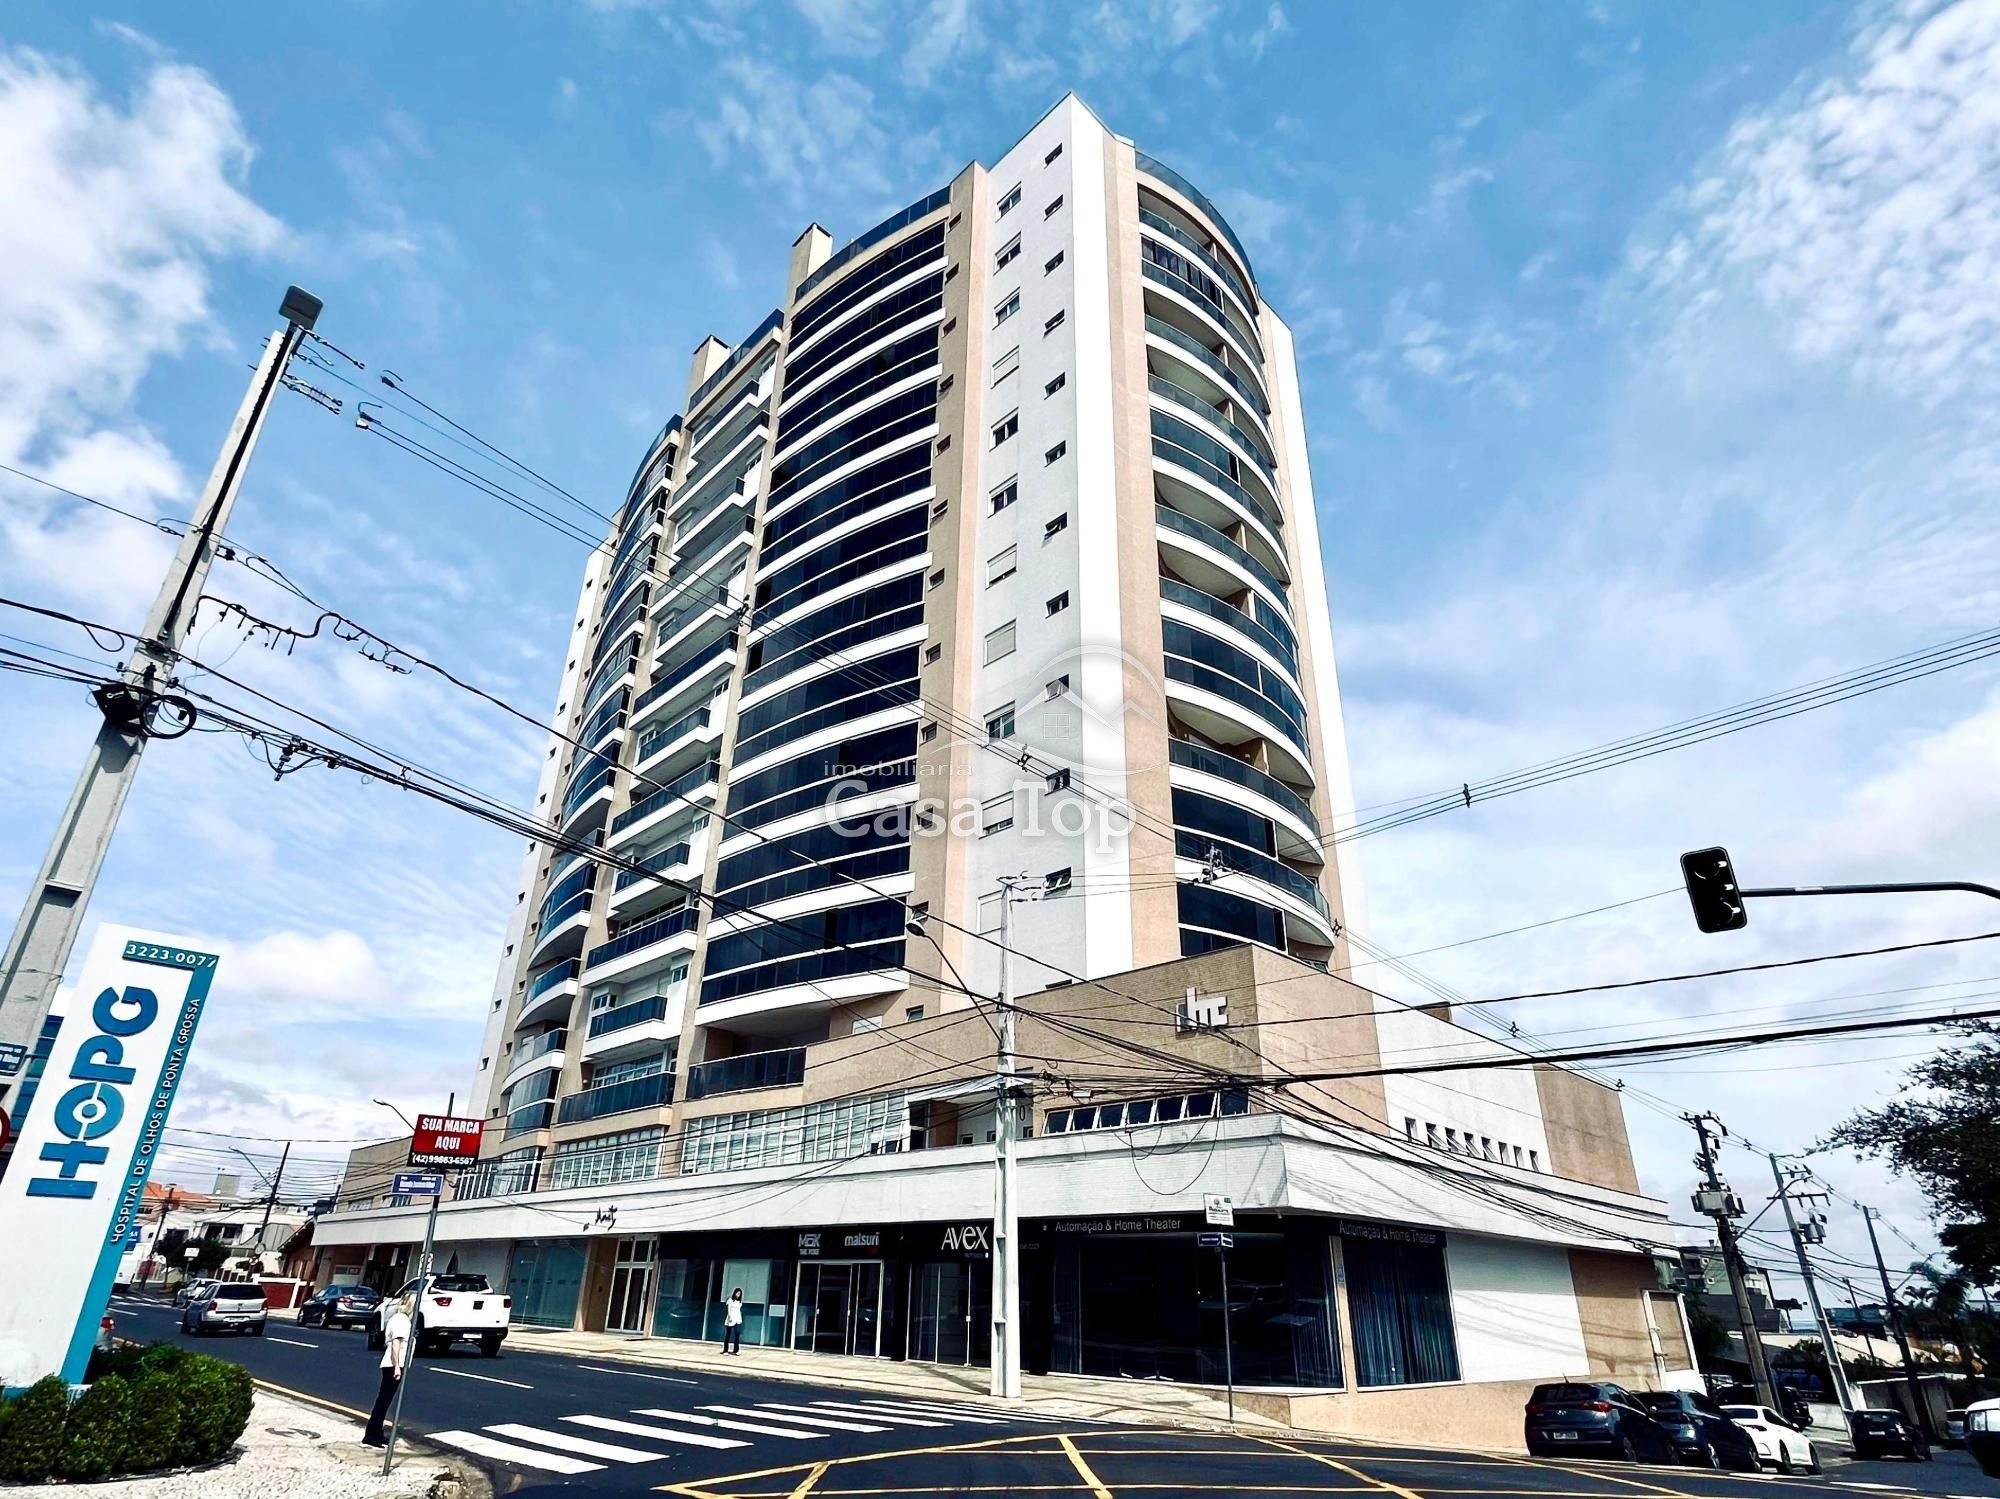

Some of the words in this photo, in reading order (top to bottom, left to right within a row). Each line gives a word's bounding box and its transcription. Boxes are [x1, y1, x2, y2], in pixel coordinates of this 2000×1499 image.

[126, 944, 216, 968] 3223-0077
[178, 998, 200, 1044] GROSSA
[163, 1048, 184, 1088] PONTA
[26, 986, 158, 1199] HOPG
[156, 1092, 170, 1108] DE
[140, 1112, 163, 1155] OLHOS
[421, 1118, 443, 1132] SUA
[443, 1120, 480, 1134] MARCA
[434, 1136, 461, 1151] AQUI
[133, 1158, 148, 1176] DE
[111, 1180, 142, 1243] HOSPITAL
[1055, 1221, 1104, 1234] Automação
[1105, 1220, 1112, 1231] &
[1114, 1220, 1142, 1231] Home
[1144, 1218, 1182, 1231] Theater
